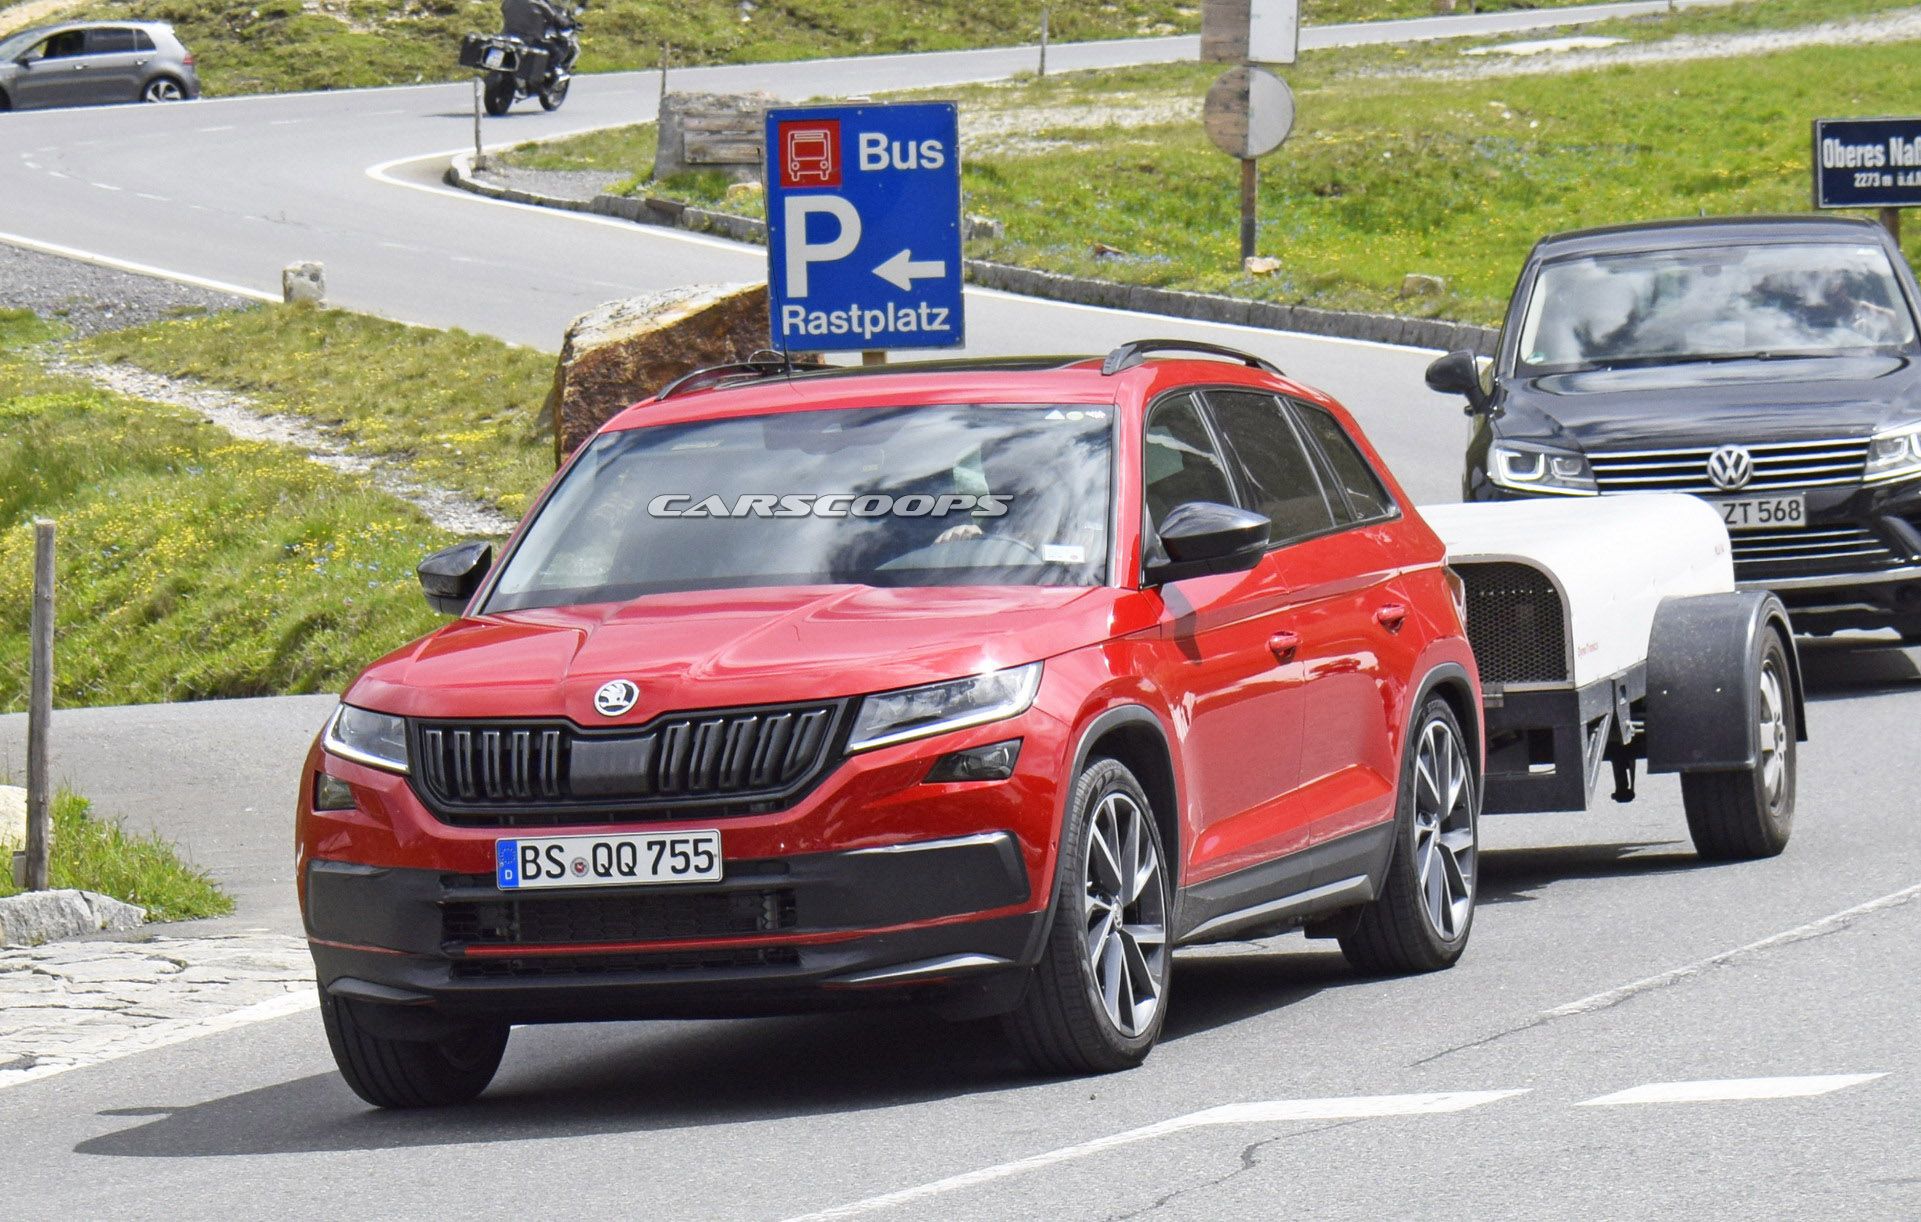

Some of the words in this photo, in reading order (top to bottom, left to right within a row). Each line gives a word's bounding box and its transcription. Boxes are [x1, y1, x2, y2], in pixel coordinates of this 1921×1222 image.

[859, 132, 945, 171] Bus
[1822, 138, 1886, 168] Oberes
[1853, 172, 1880, 187] 2273
[785, 195, 862, 297] P
[782, 302, 950, 339] Rastplatz
[1722, 502, 1752, 525] ZT
[1758, 500, 1801, 522] 568
[504, 869, 513, 880] D
[520, 844, 566, 880] BS
[592, 841, 637, 877] QQ
[647, 838, 714, 875] 755
